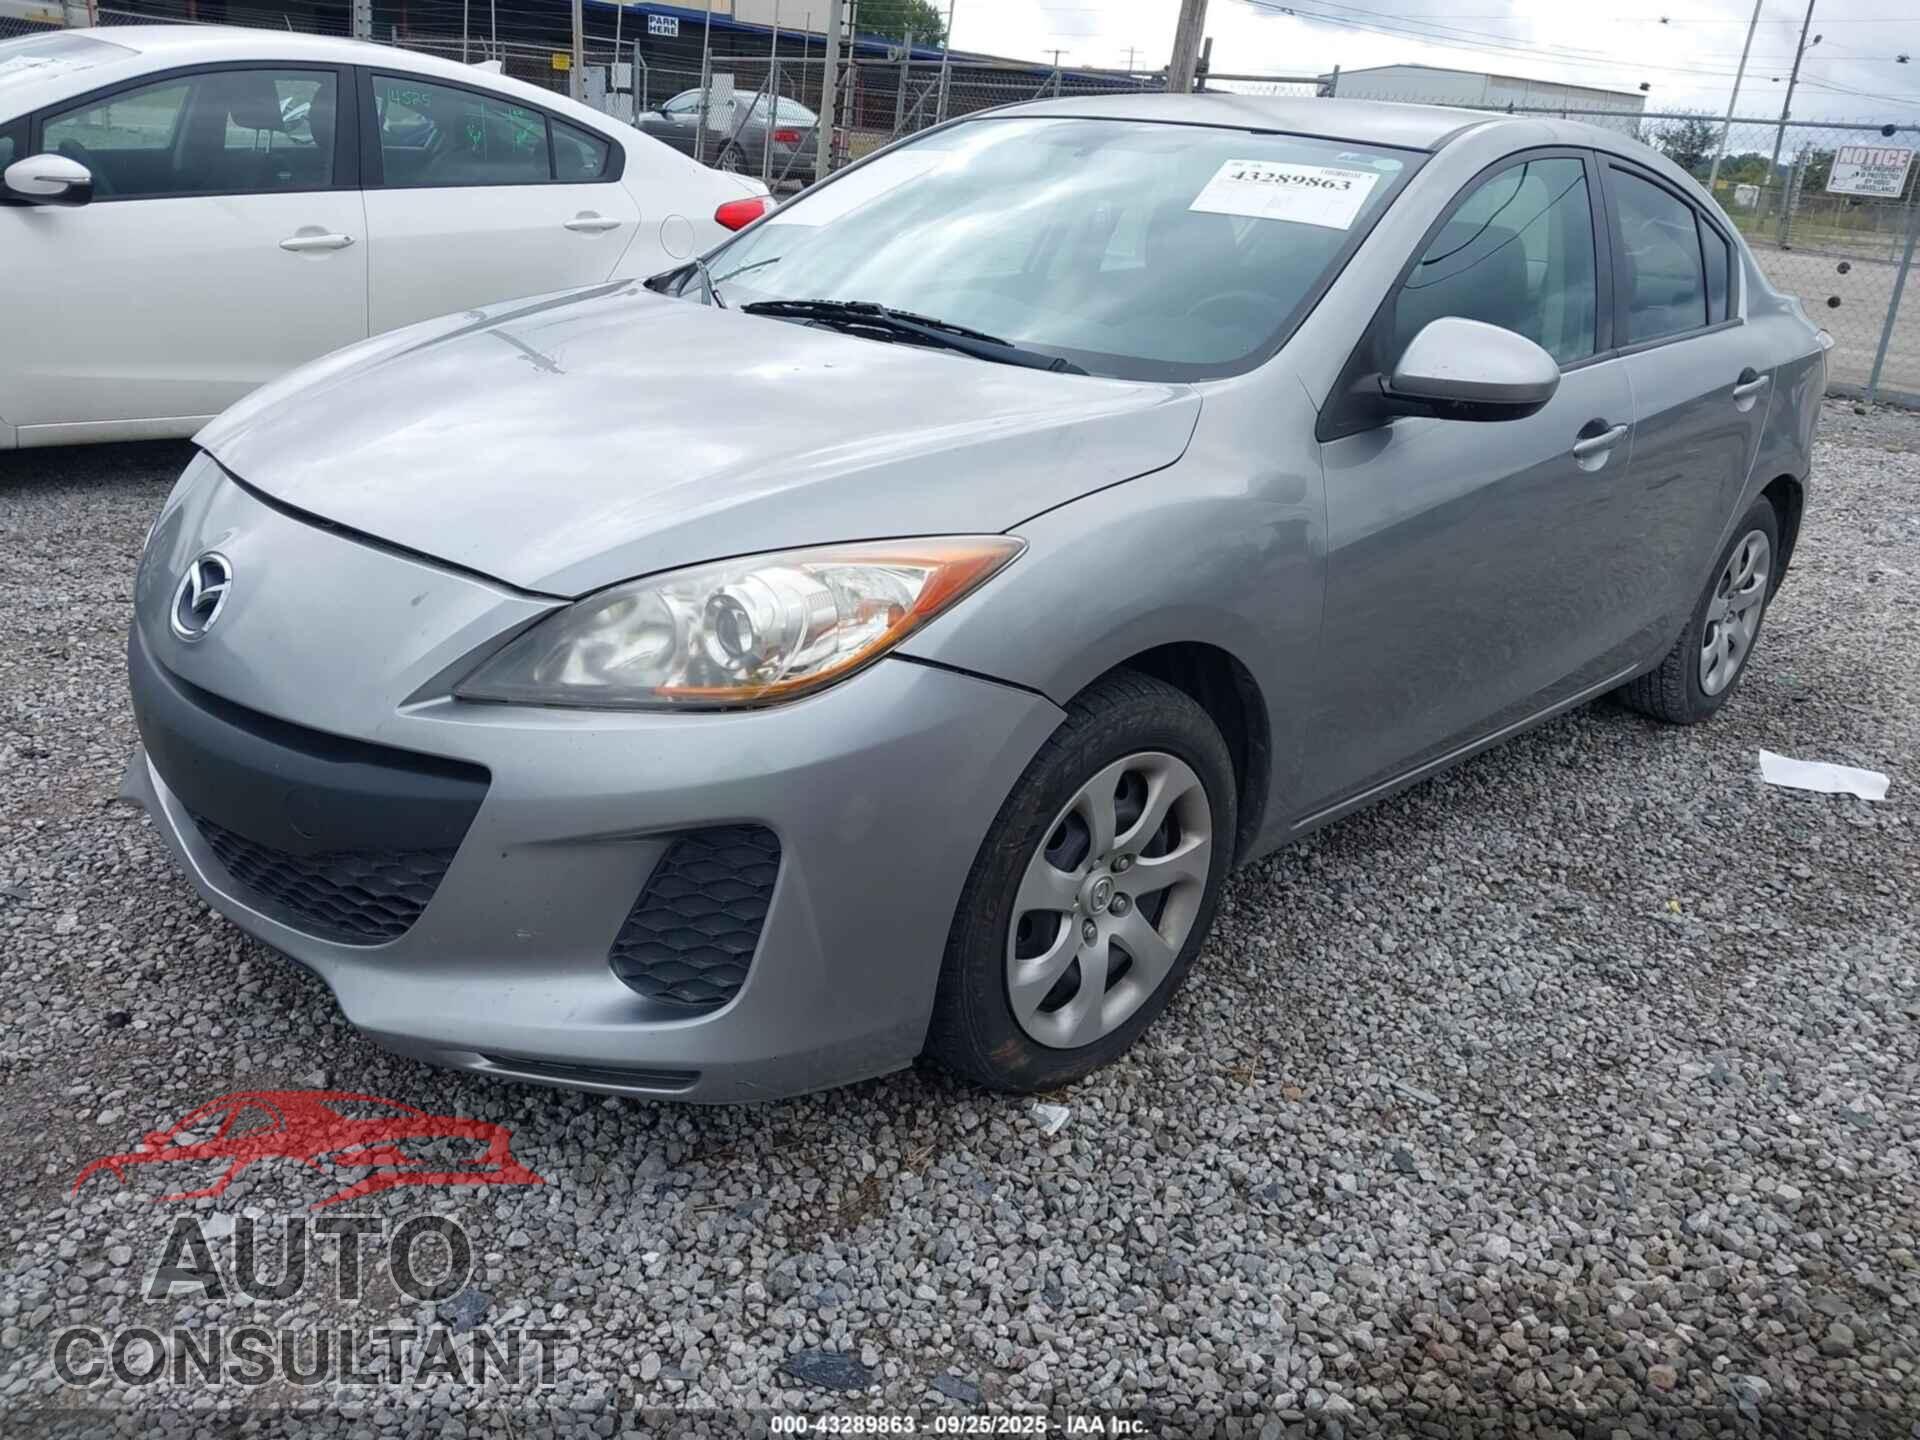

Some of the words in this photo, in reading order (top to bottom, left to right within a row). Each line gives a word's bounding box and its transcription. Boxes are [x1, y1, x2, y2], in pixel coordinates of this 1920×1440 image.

[649, 16, 677, 25] PARK
[650, 25, 677, 35] HERE
[1839, 147, 1909, 167] NOTICE
[1230, 170, 1352, 191] 43289863
